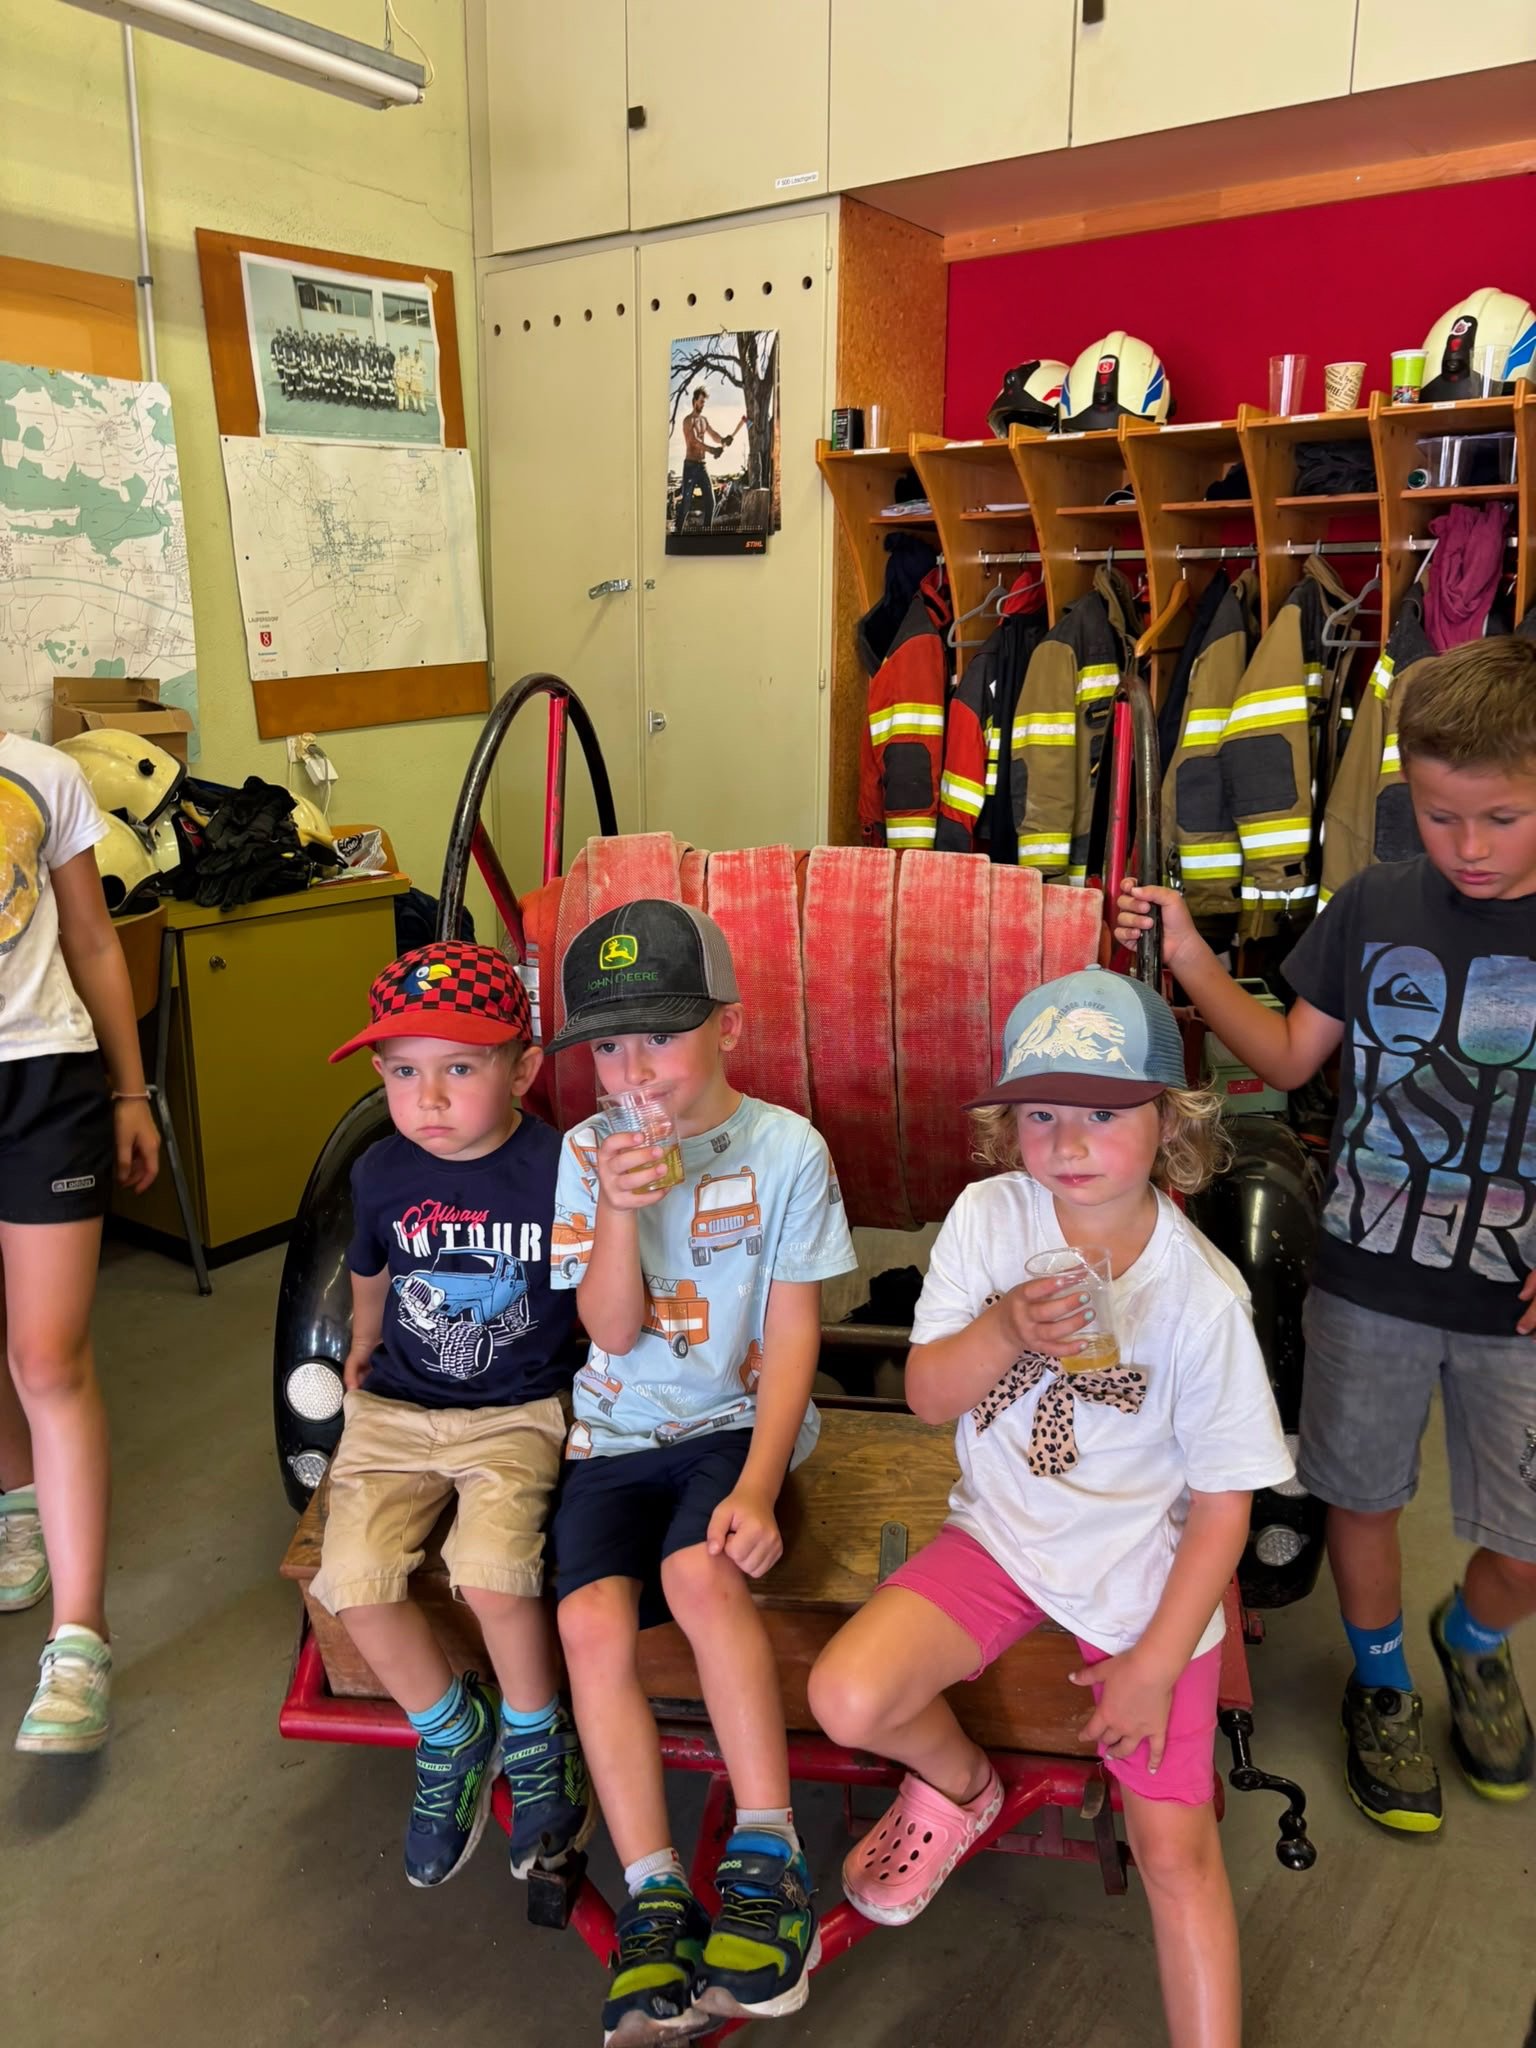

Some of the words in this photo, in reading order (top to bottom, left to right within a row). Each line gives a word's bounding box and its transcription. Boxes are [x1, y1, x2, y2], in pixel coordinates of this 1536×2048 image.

[584, 976, 613, 992] JOHN
[615, 971, 658, 983] DEERE
[400, 1199, 490, 1239] Always
[441, 1222, 542, 1262] TOUR
